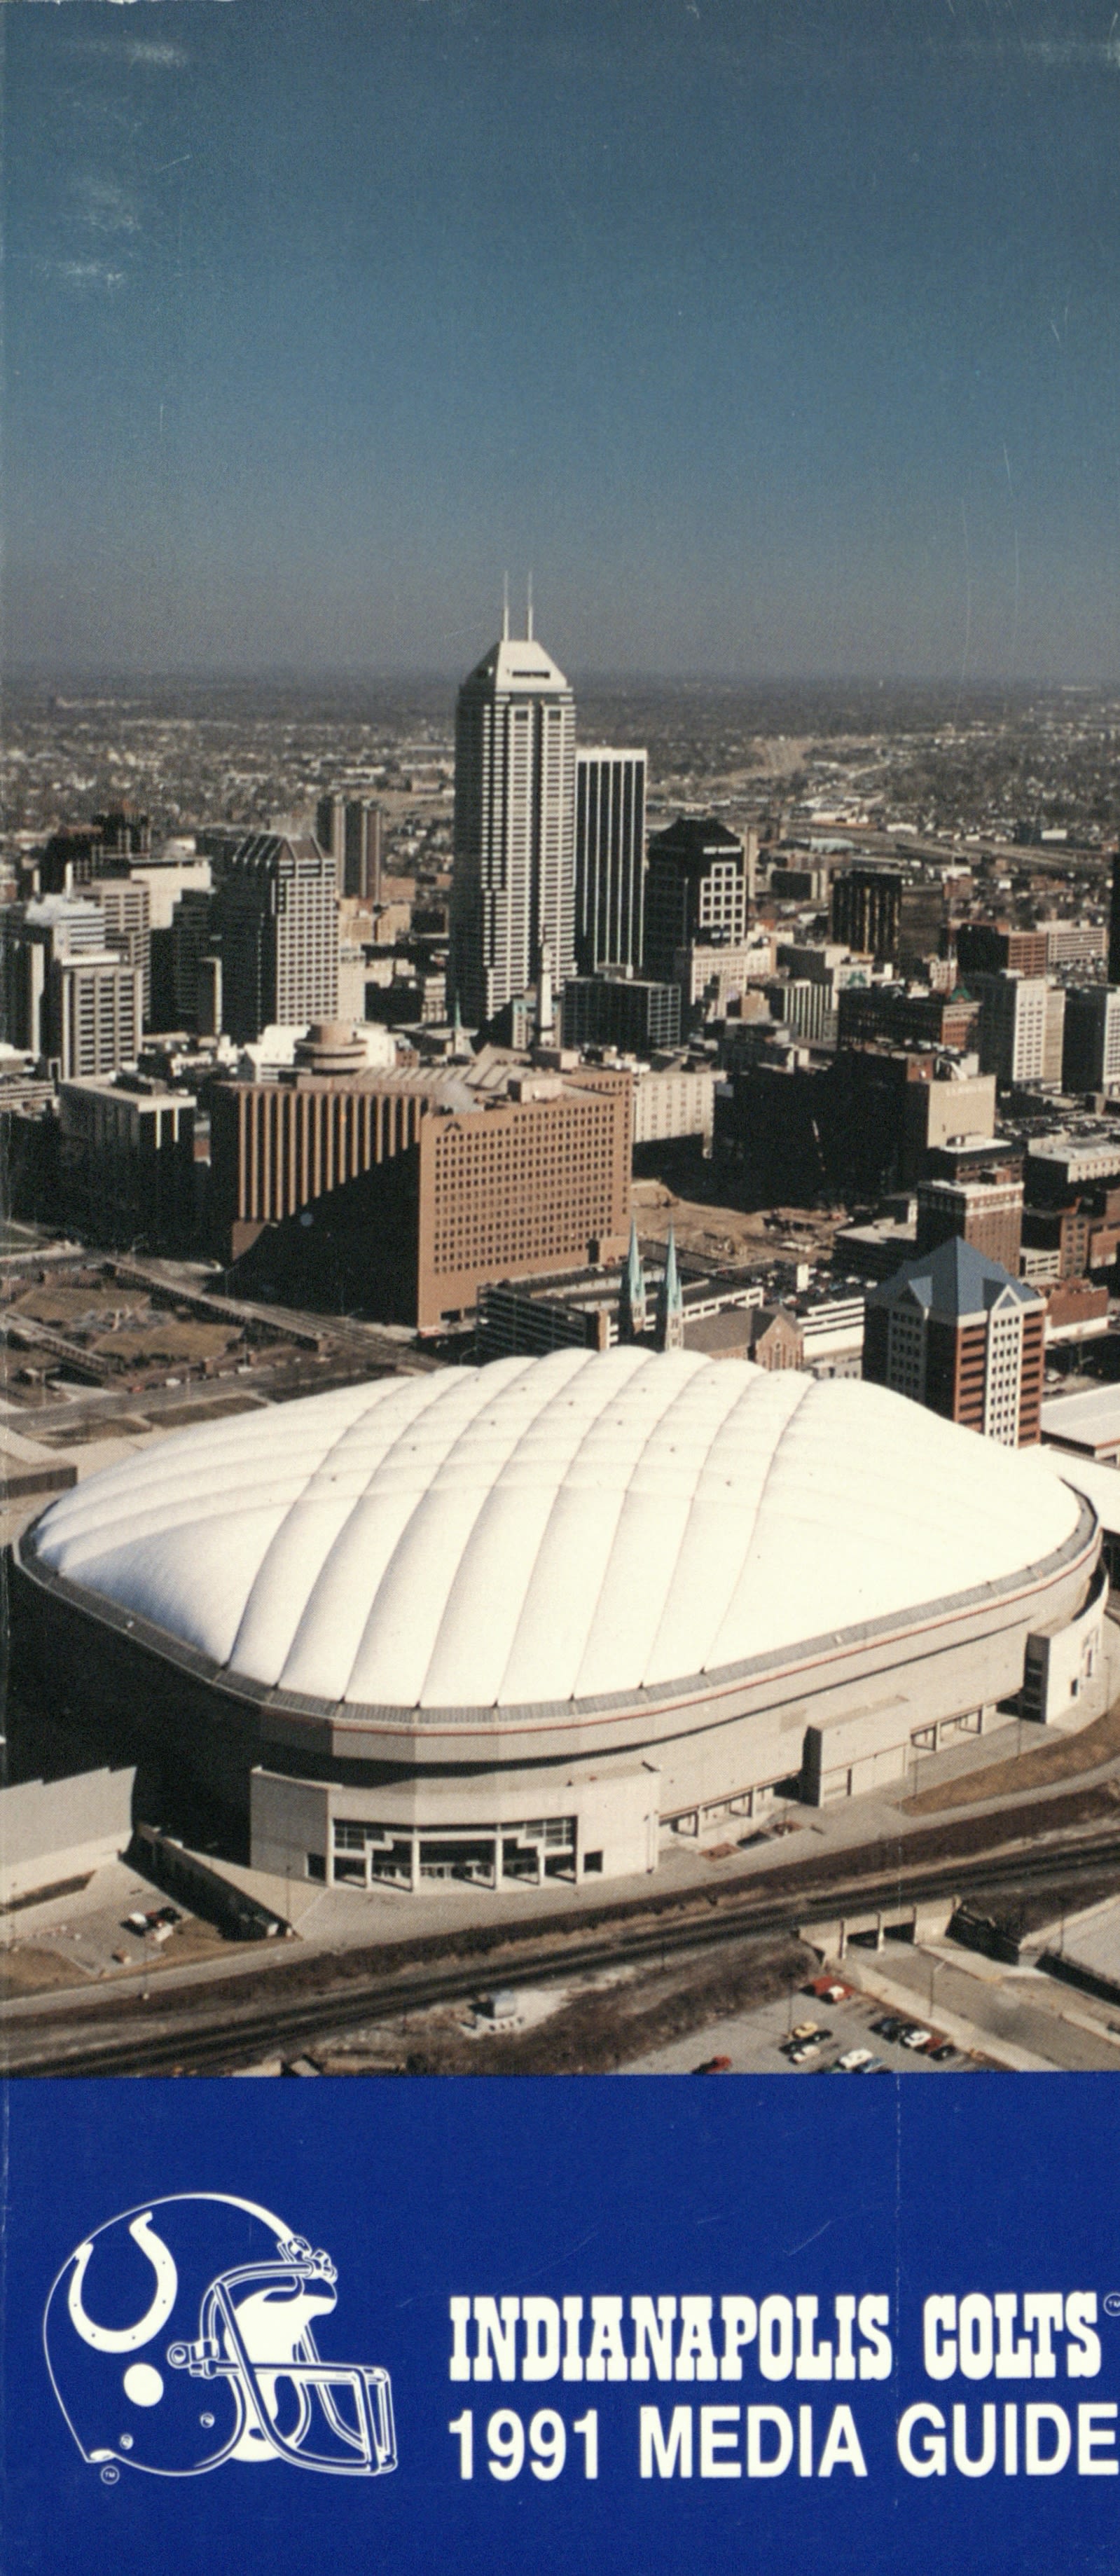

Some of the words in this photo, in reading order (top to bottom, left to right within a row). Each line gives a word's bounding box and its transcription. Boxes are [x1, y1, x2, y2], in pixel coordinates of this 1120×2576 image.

[450, 2294, 892, 2381] INDIANAPOLIS
[923, 2291, 1102, 2381] COLTS
[449, 2409, 598, 2481] 1991
[639, 2404, 868, 2479] MEDIA
[898, 2402, 1120, 2478] GUIDE
